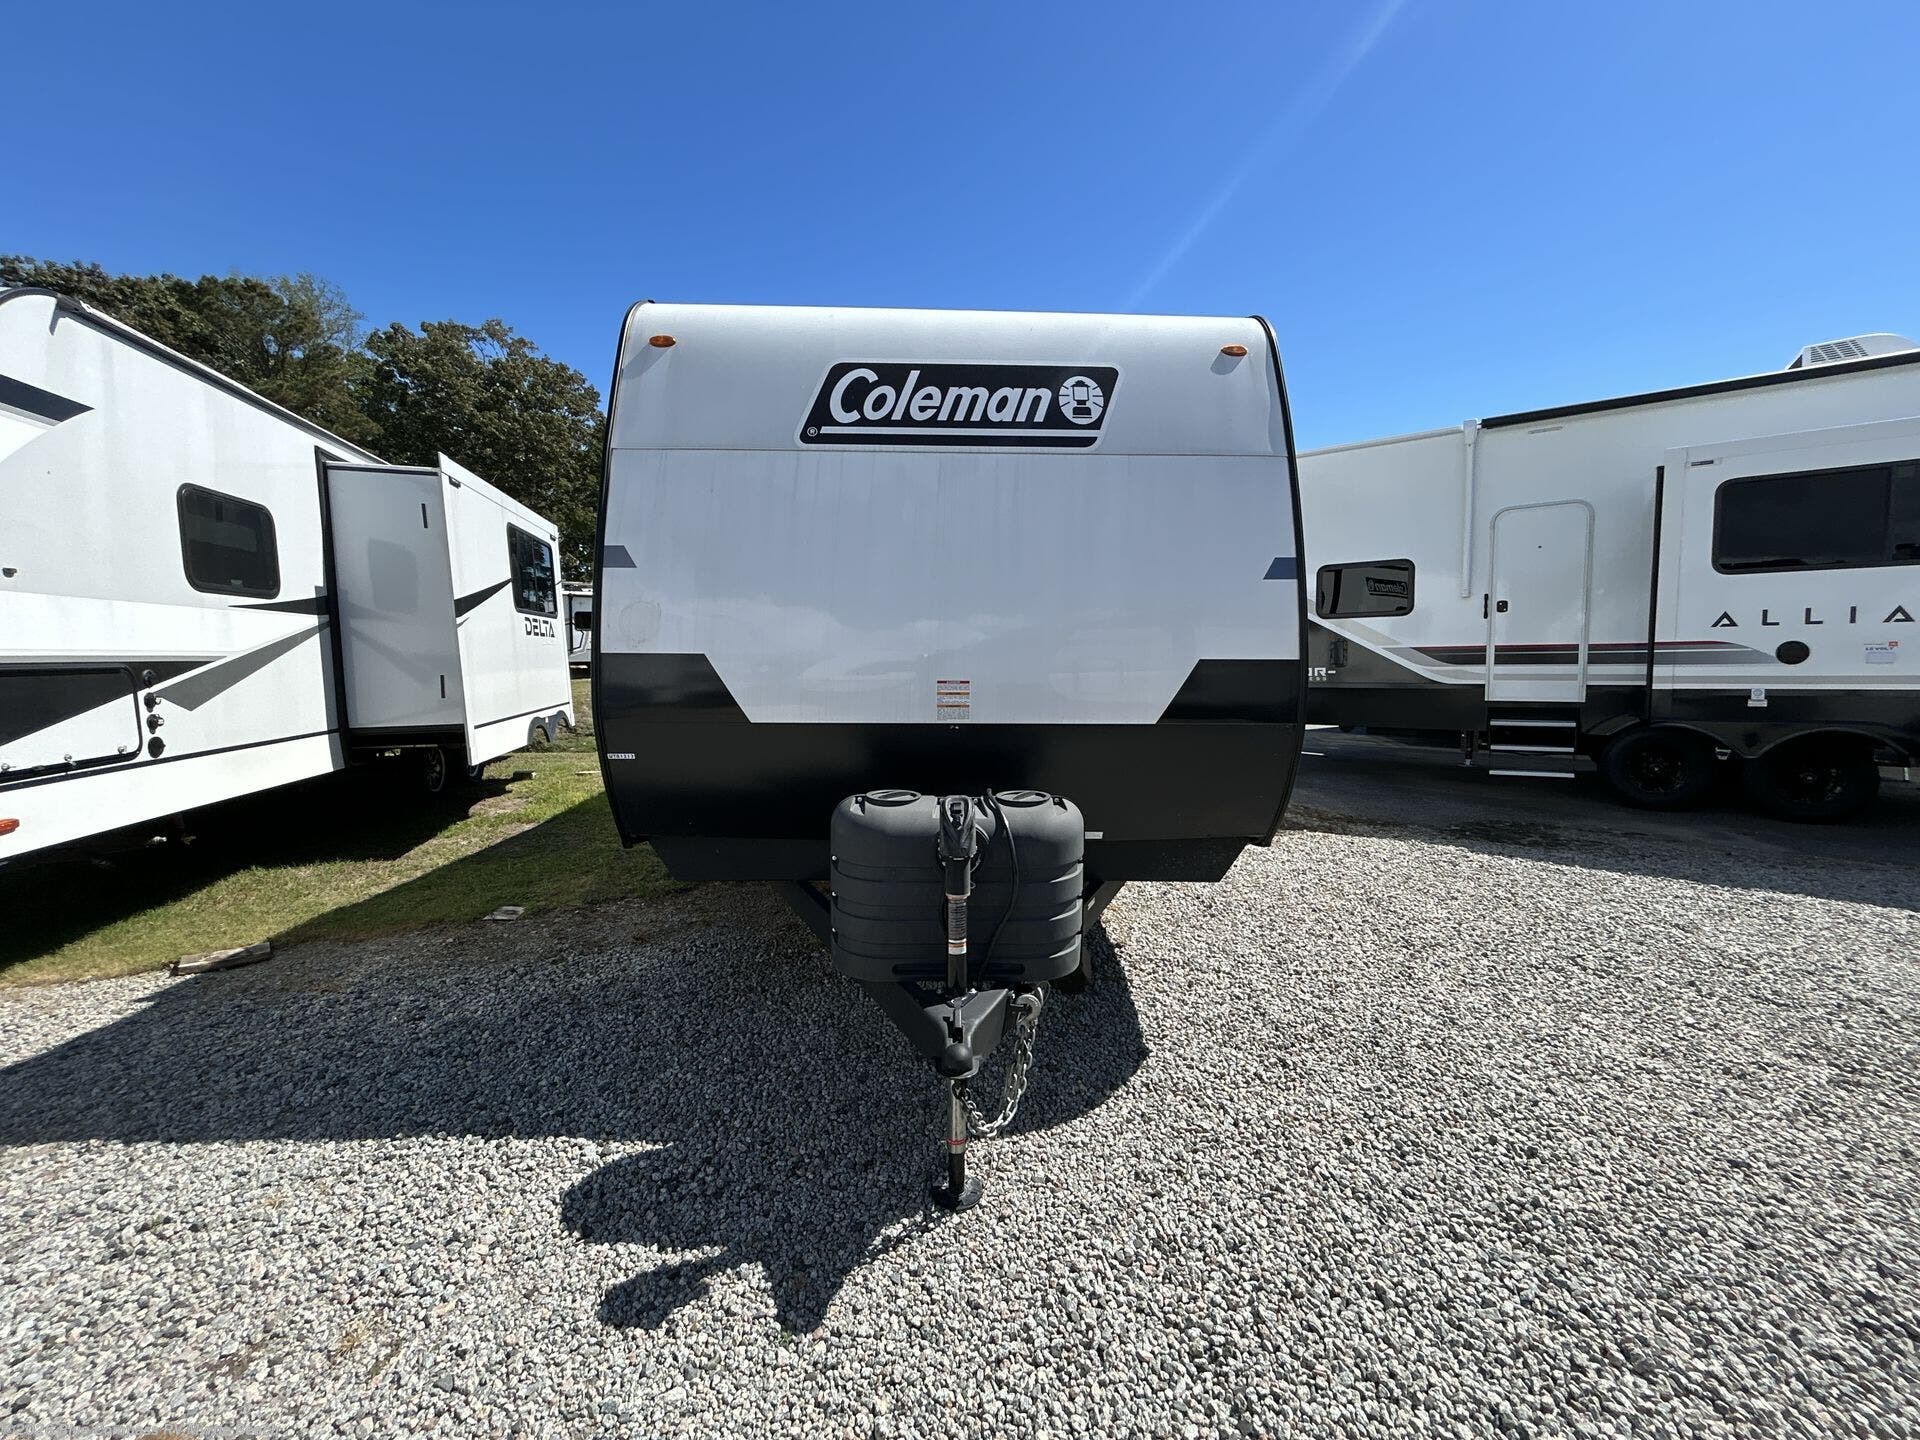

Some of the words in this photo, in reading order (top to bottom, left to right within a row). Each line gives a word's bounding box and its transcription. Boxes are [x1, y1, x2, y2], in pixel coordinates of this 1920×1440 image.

[829, 368, 1053, 424] Coleman
[524, 616, 555, 638] DELTA
[1710, 604, 1916, 628] ALLIA
